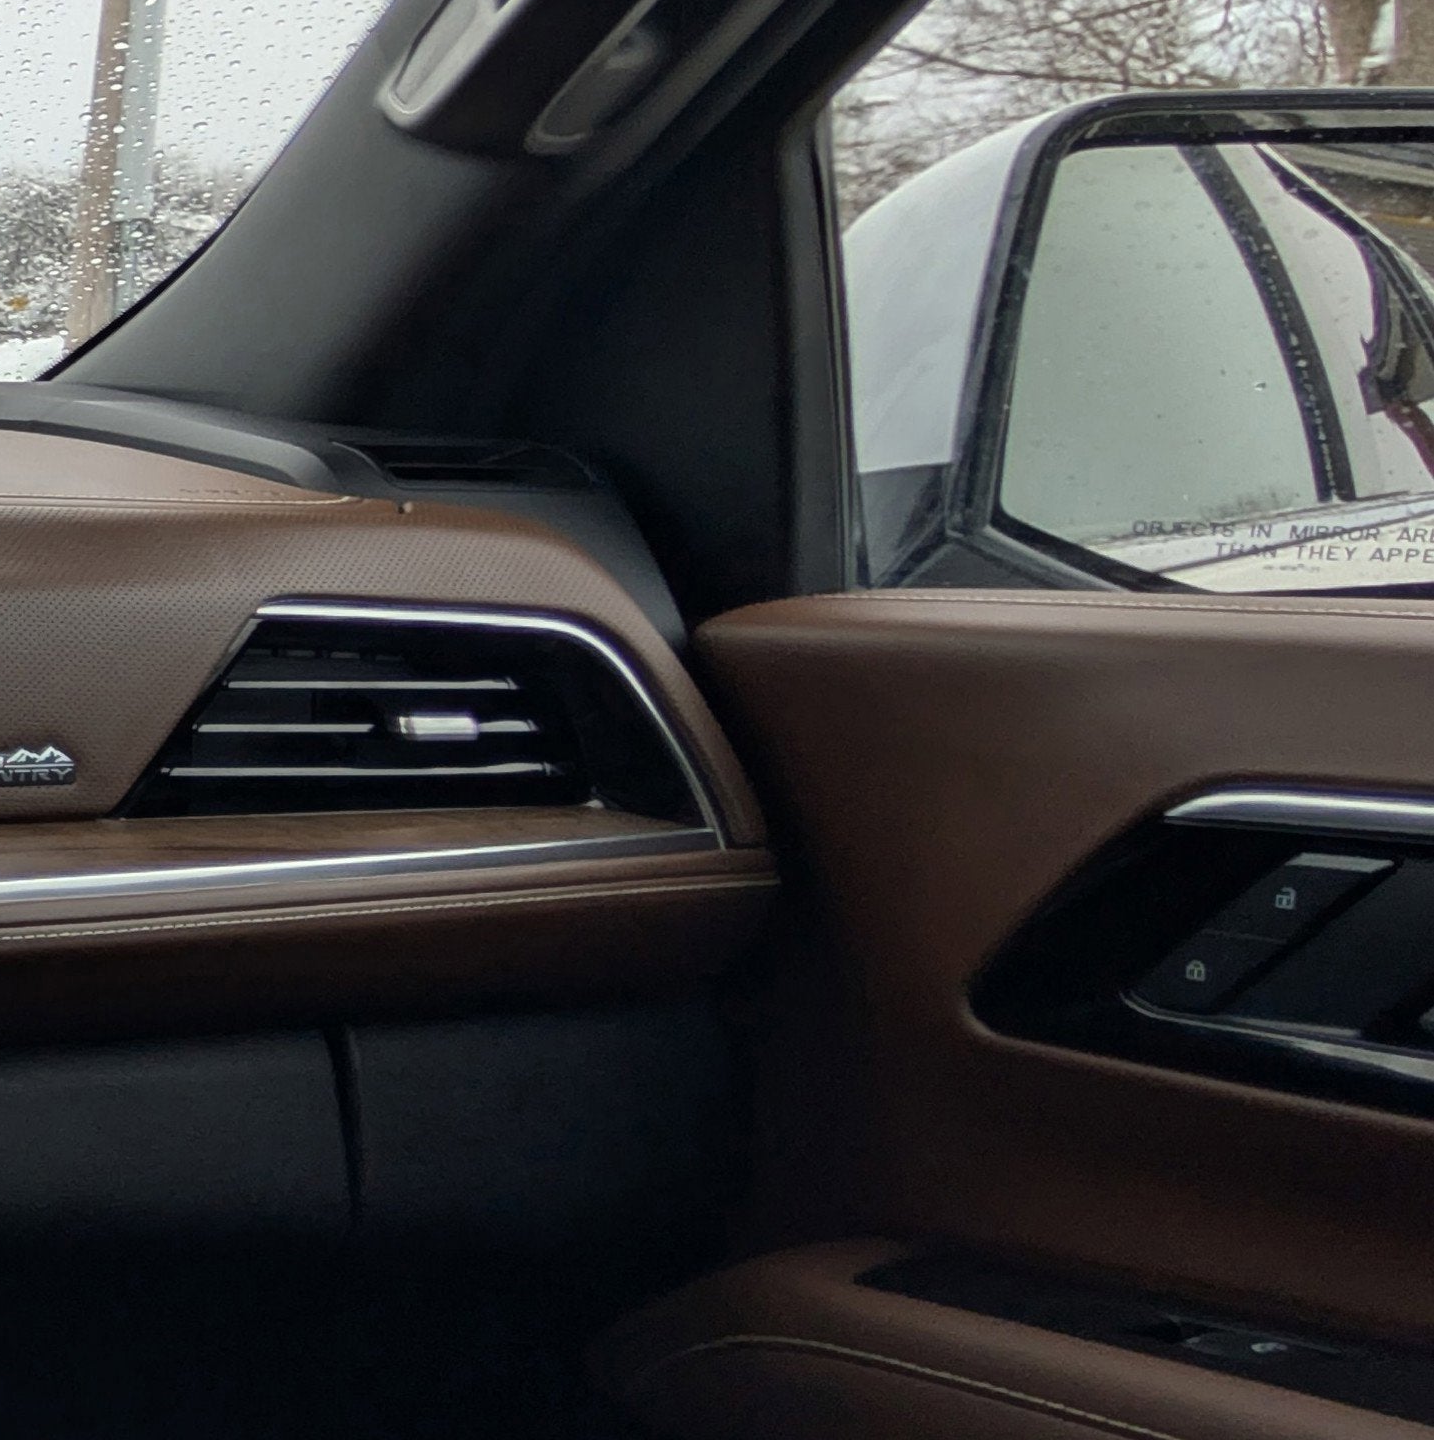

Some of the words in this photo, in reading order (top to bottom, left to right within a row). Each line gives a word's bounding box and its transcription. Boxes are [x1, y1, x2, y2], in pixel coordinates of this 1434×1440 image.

[1132, 521, 1235, 538] OBJECTS
[1249, 524, 1273, 539] IN
[1288, 525, 1381, 542] MIRROR
[1297, 545, 1358, 562] THEY
